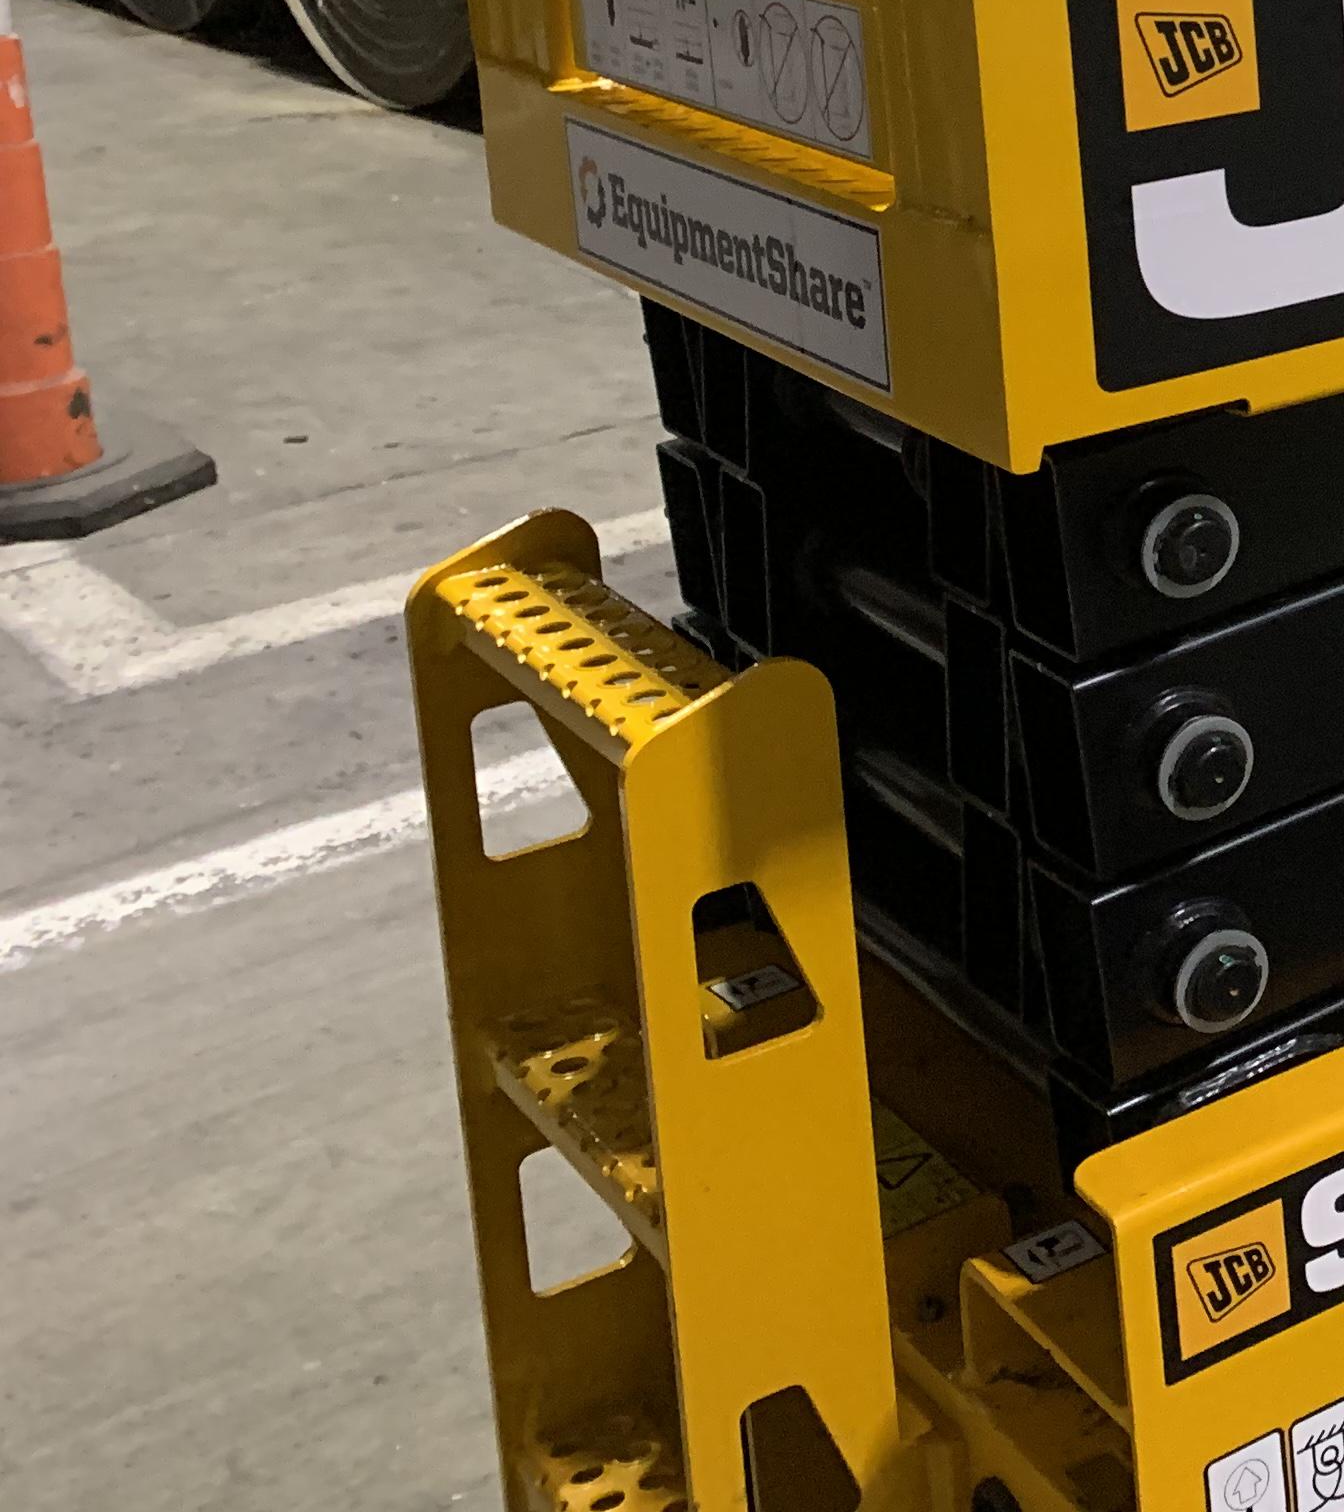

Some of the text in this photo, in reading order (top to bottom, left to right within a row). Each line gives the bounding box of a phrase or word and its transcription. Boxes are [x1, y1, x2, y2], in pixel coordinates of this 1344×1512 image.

[1155, 18, 1235, 85] JCB
[607, 173, 867, 330] EquipmentShare
[1203, 1243, 1269, 1312] JCB
